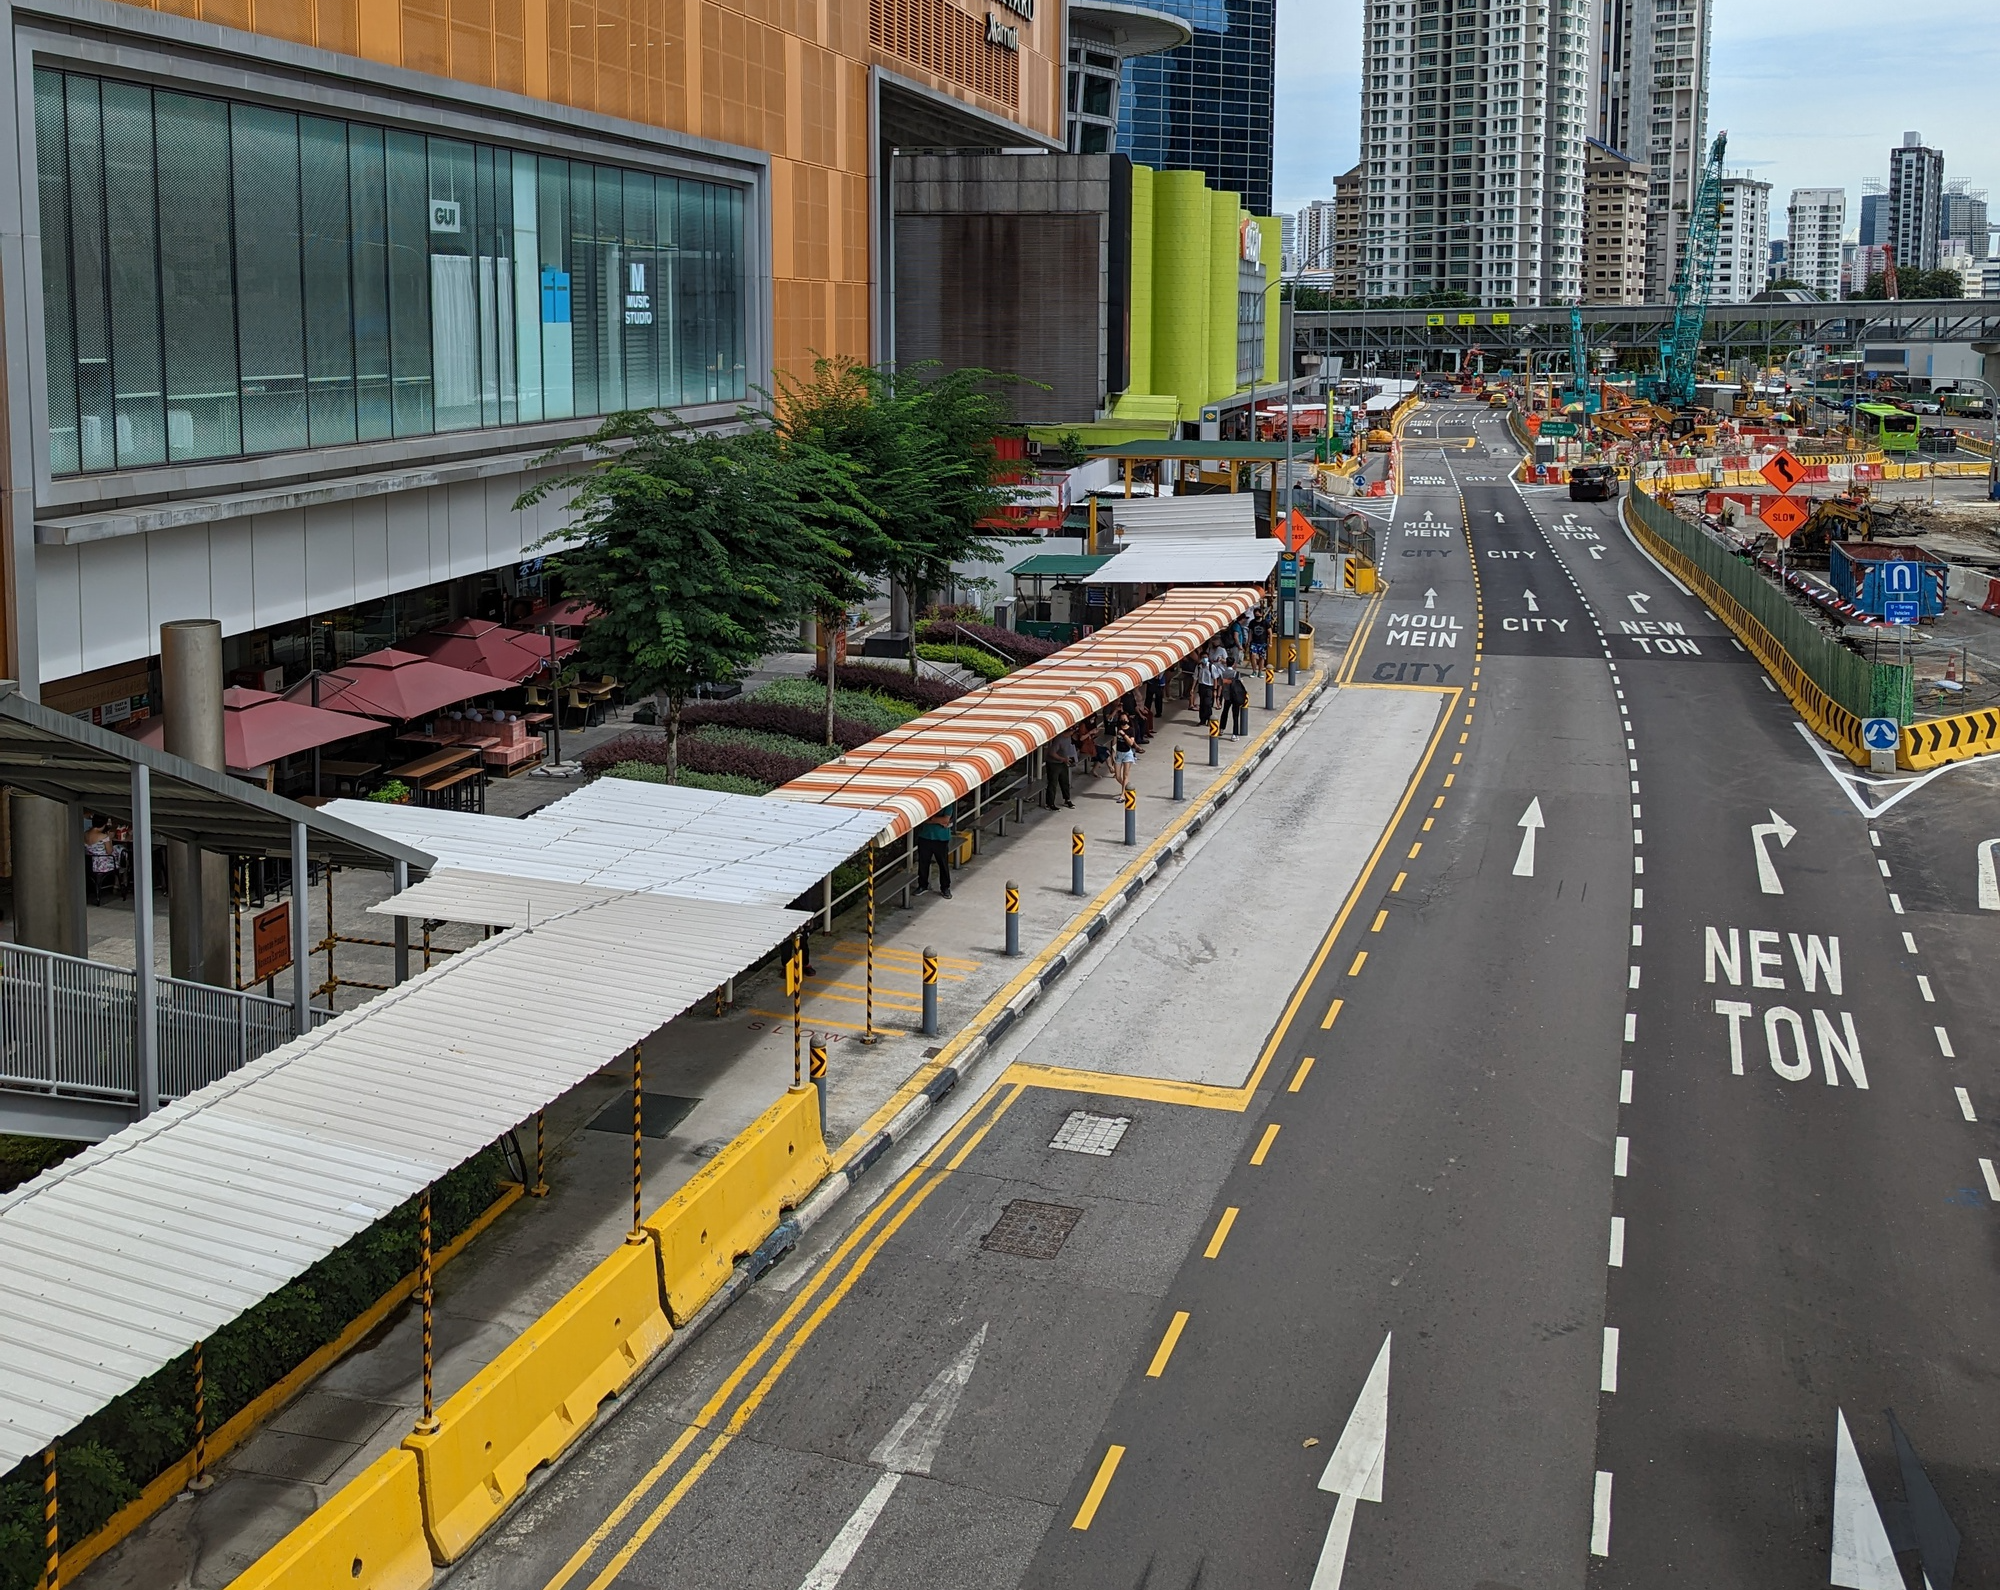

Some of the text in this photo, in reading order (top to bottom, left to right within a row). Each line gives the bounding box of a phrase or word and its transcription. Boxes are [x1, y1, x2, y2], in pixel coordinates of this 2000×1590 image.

[434, 207, 456, 226] GUI
[629, 263, 645, 292] M
[626, 295, 650, 308] MUSIC
[625, 311, 652, 325] STUDIO
[1746, 402, 1758, 411] CAT
[1772, 513, 1796, 522] SLOW
[1559, 532, 1600, 540] TON
[1401, 550, 1453, 558] CITY
[1487, 550, 1537, 560] CITY
[1387, 613, 1463, 629] MOUL
[1502, 618, 1569, 632] CITY
[1619, 620, 1686, 635] NEW
[1386, 630, 1457, 648] MEIN
[1631, 637, 1702, 655] TON
[1372, 662, 1455, 683] CITY
[1705, 926, 1842, 995] NEW
[747, 1022, 848, 1042] SLOW
[1714, 999, 1869, 1090] TON
